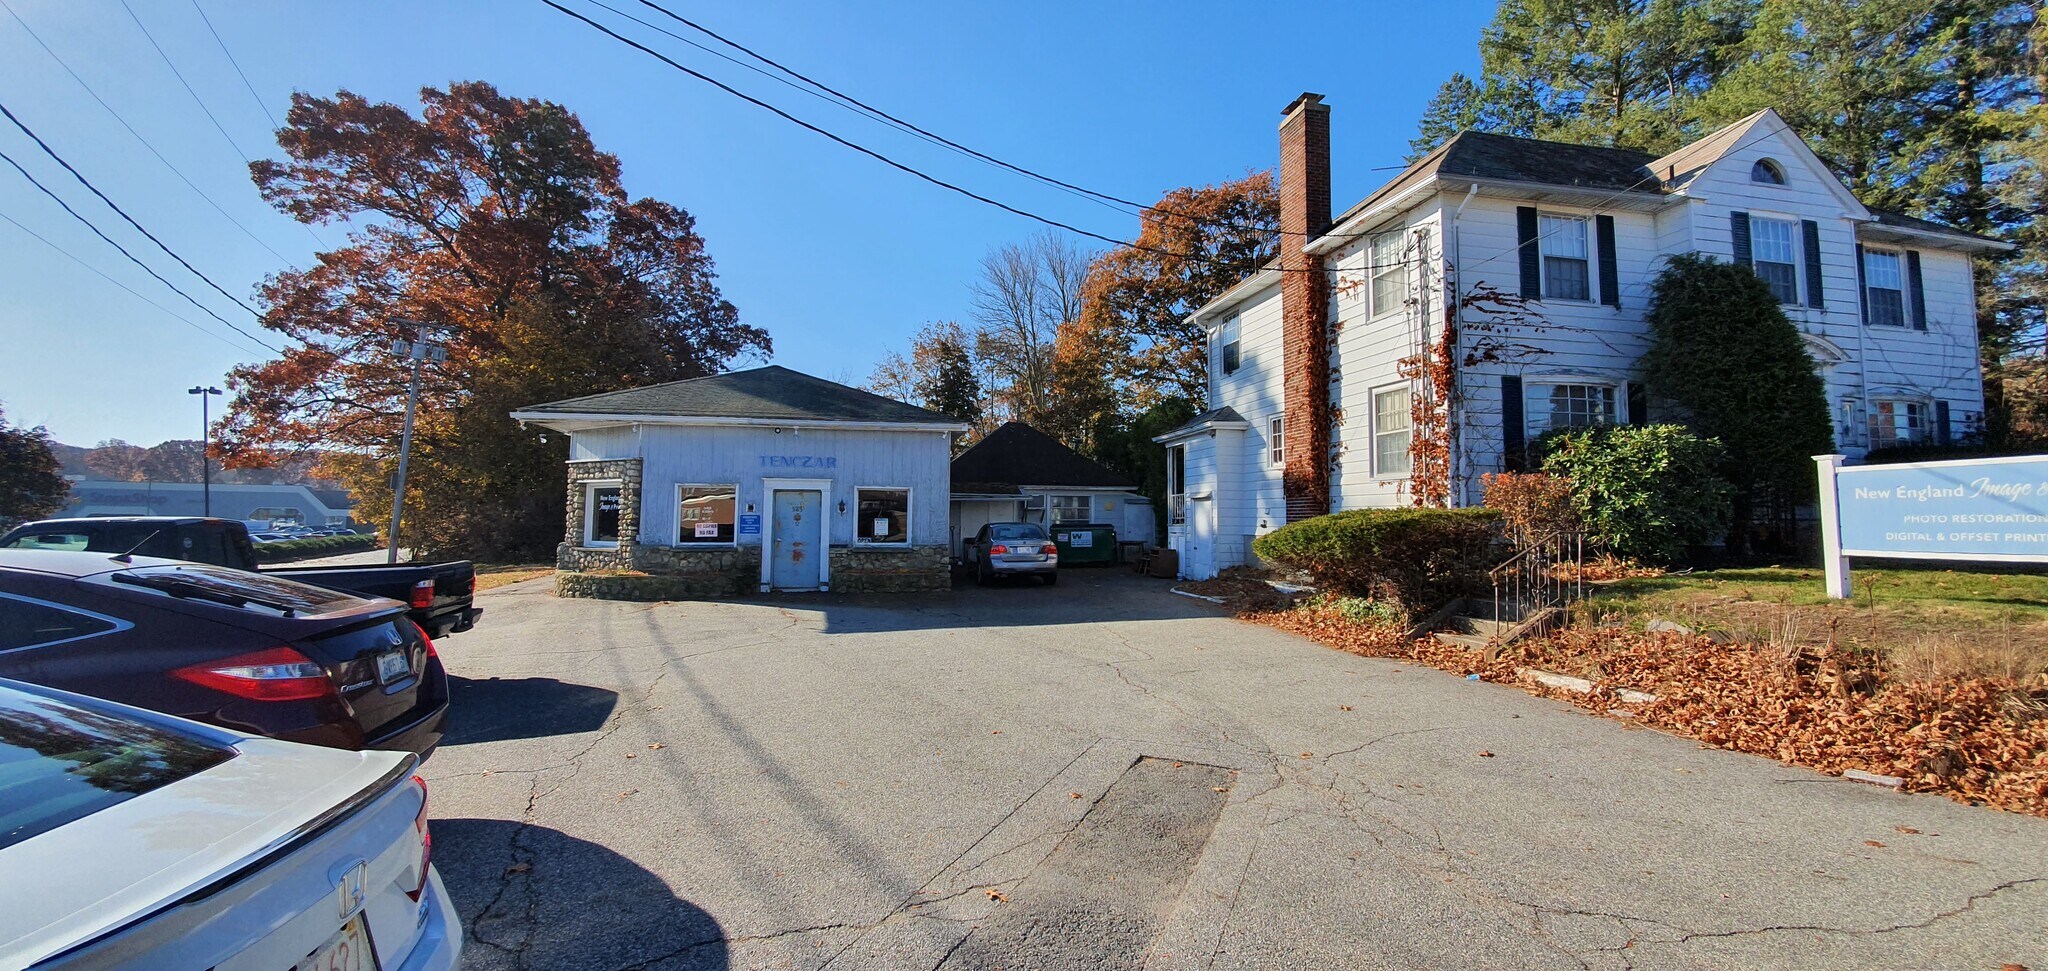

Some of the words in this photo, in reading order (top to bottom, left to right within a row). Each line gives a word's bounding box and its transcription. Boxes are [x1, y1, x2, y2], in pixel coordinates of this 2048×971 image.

[759, 455, 837, 468] TENCZAR
[1855, 487, 1891, 499] New
[1896, 484, 1964, 502] England
[1969, 477, 2032, 502] Image
[1903, 515, 1948, 524] PHOTO
[1952, 514, 2048, 523] RESTORATION
[1886, 532, 1932, 541] DIGITAL
[1936, 533, 1945, 541] &
[1949, 532, 1999, 542] OFFSET
